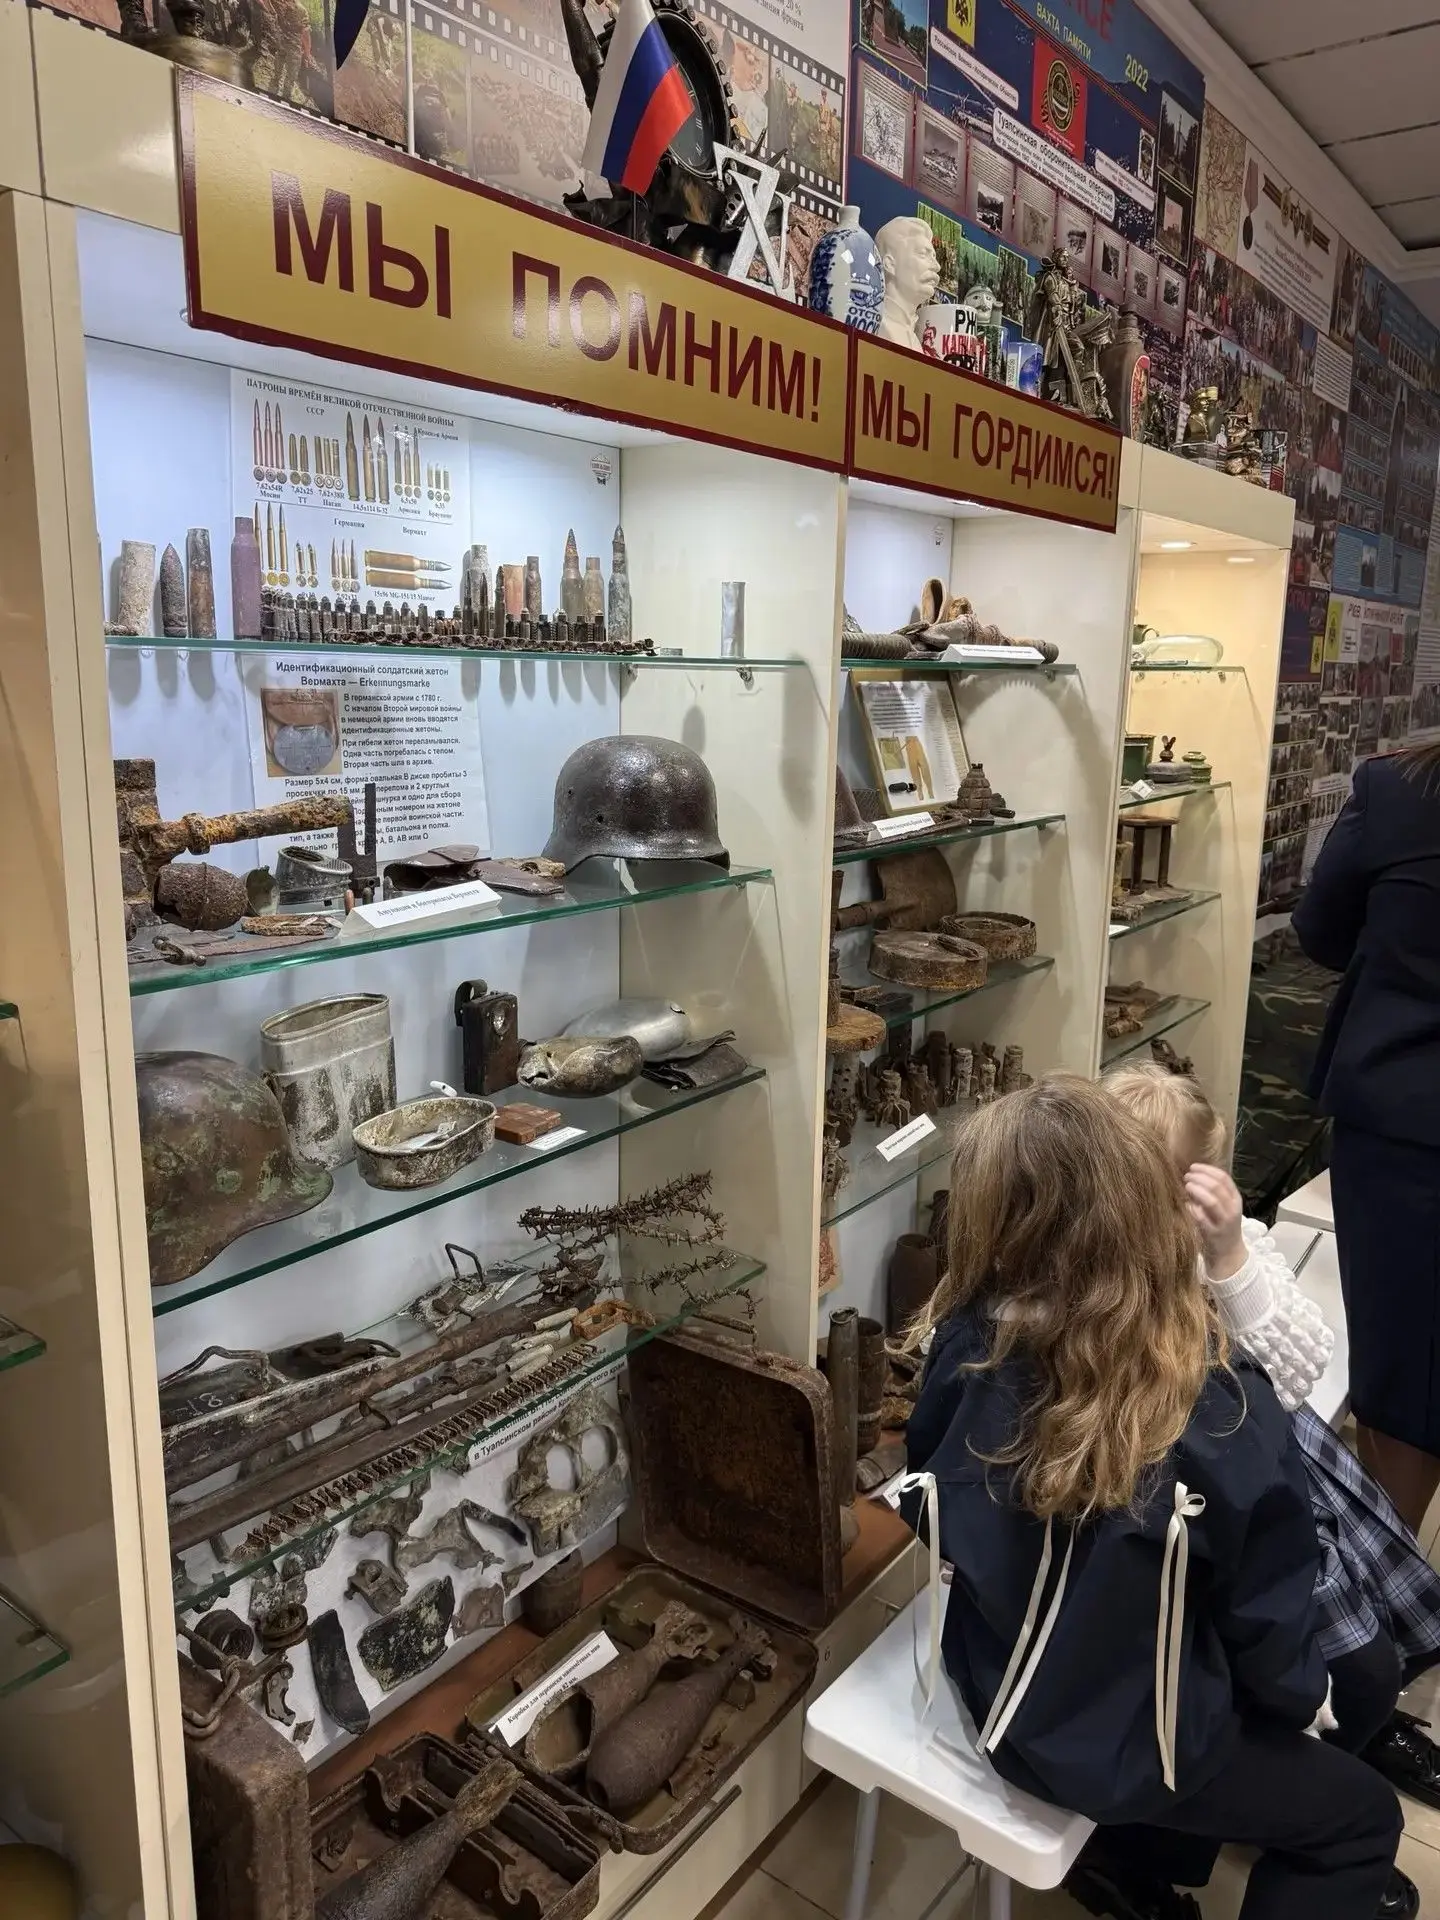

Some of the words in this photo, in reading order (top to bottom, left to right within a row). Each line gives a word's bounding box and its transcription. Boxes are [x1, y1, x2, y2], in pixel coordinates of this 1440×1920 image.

[1036, 2, 1061, 34] ВАХТА
[1063, 25, 1092, 62] ПАМЯТИ
[1125, 53, 1149, 93] 2022
[998, 110, 1038, 149] Туапсинская
[271, 169, 452, 320] МЫ
[513, 251, 822, 423] ПОМНИМ!
[246, 378, 287, 394] ПАТРОНЫ
[288, 386, 322, 402] ВРЕМЁН
[323, 394, 362, 410] ВЕЛИКОЙ
[362, 402, 426, 423] ОТЕЧЕСТВЕННОЙ
[427, 415, 455, 427] ВОЙНЫ
[306, 406, 325, 416] СССР
[862, 374, 931, 452] МЫ
[953, 403, 1115, 500] ГОРДИМСЯ!
[334, 518, 365, 529] Германия
[402, 526, 427, 536] Вермахт
[276, 661, 376, 674] Идентификационный
[377, 665, 424, 676] солдатский
[424, 668, 449, 676] жетон
[300, 676, 347, 687] Вермахта
[359, 677, 431, 689] Erkennungsmarke
[343, 693, 350, 701] В
[351, 694, 391, 702] германской
[393, 695, 414, 703] армии
[421, 694, 436, 702] 1780
[344, 704, 350, 712] С
[383, 704, 408, 713] Второй
[409, 704, 439, 713] мировой
[439, 704, 462, 712] войны
[347, 715, 381, 724] немецкой
[383, 716, 404, 724] армии
[427, 715, 459, 723] вводятся
[341, 726, 413, 734] идентификационные
[414, 725, 442, 733] жетоны.
[342, 739, 357, 748] При
[358, 739, 382, 747] гибели
[405, 737, 461, 746] переламывался.
[343, 749, 362, 757] Одна
[383, 748, 426, 757] погребалась
[433, 747, 456, 755] телом.
[343, 760, 369, 769] Вторая
[411, 758, 434, 767] архив.
[284, 778, 314, 788] Размер
[330, 777, 343, 785] см,
[344, 775, 369, 784] форма
[369, 774, 403, 782] овальная
[403, 772, 409, 780] В
[410, 772, 430, 781] диске
[431, 770, 461, 779] пробиты
[416, 782, 421, 790] 2
[422, 782, 450, 790] круглых
[408, 793, 425, 801] одно
[426, 792, 439, 800] для
[440, 790, 461, 798] сбора
[394, 804, 425, 812] номером
[382, 814, 407, 823] первой
[408, 812, 441, 821] воинской
[289, 835, 305, 843] тип,
[312, 832, 335, 840] также
[385, 825, 421, 833] батальона
[473, 1452, 480, 1461] в
[480, 1421, 532, 1457] Туапсинском
[507, 1704, 530, 1724] Коробки
[529, 1696, 540, 1708] для
